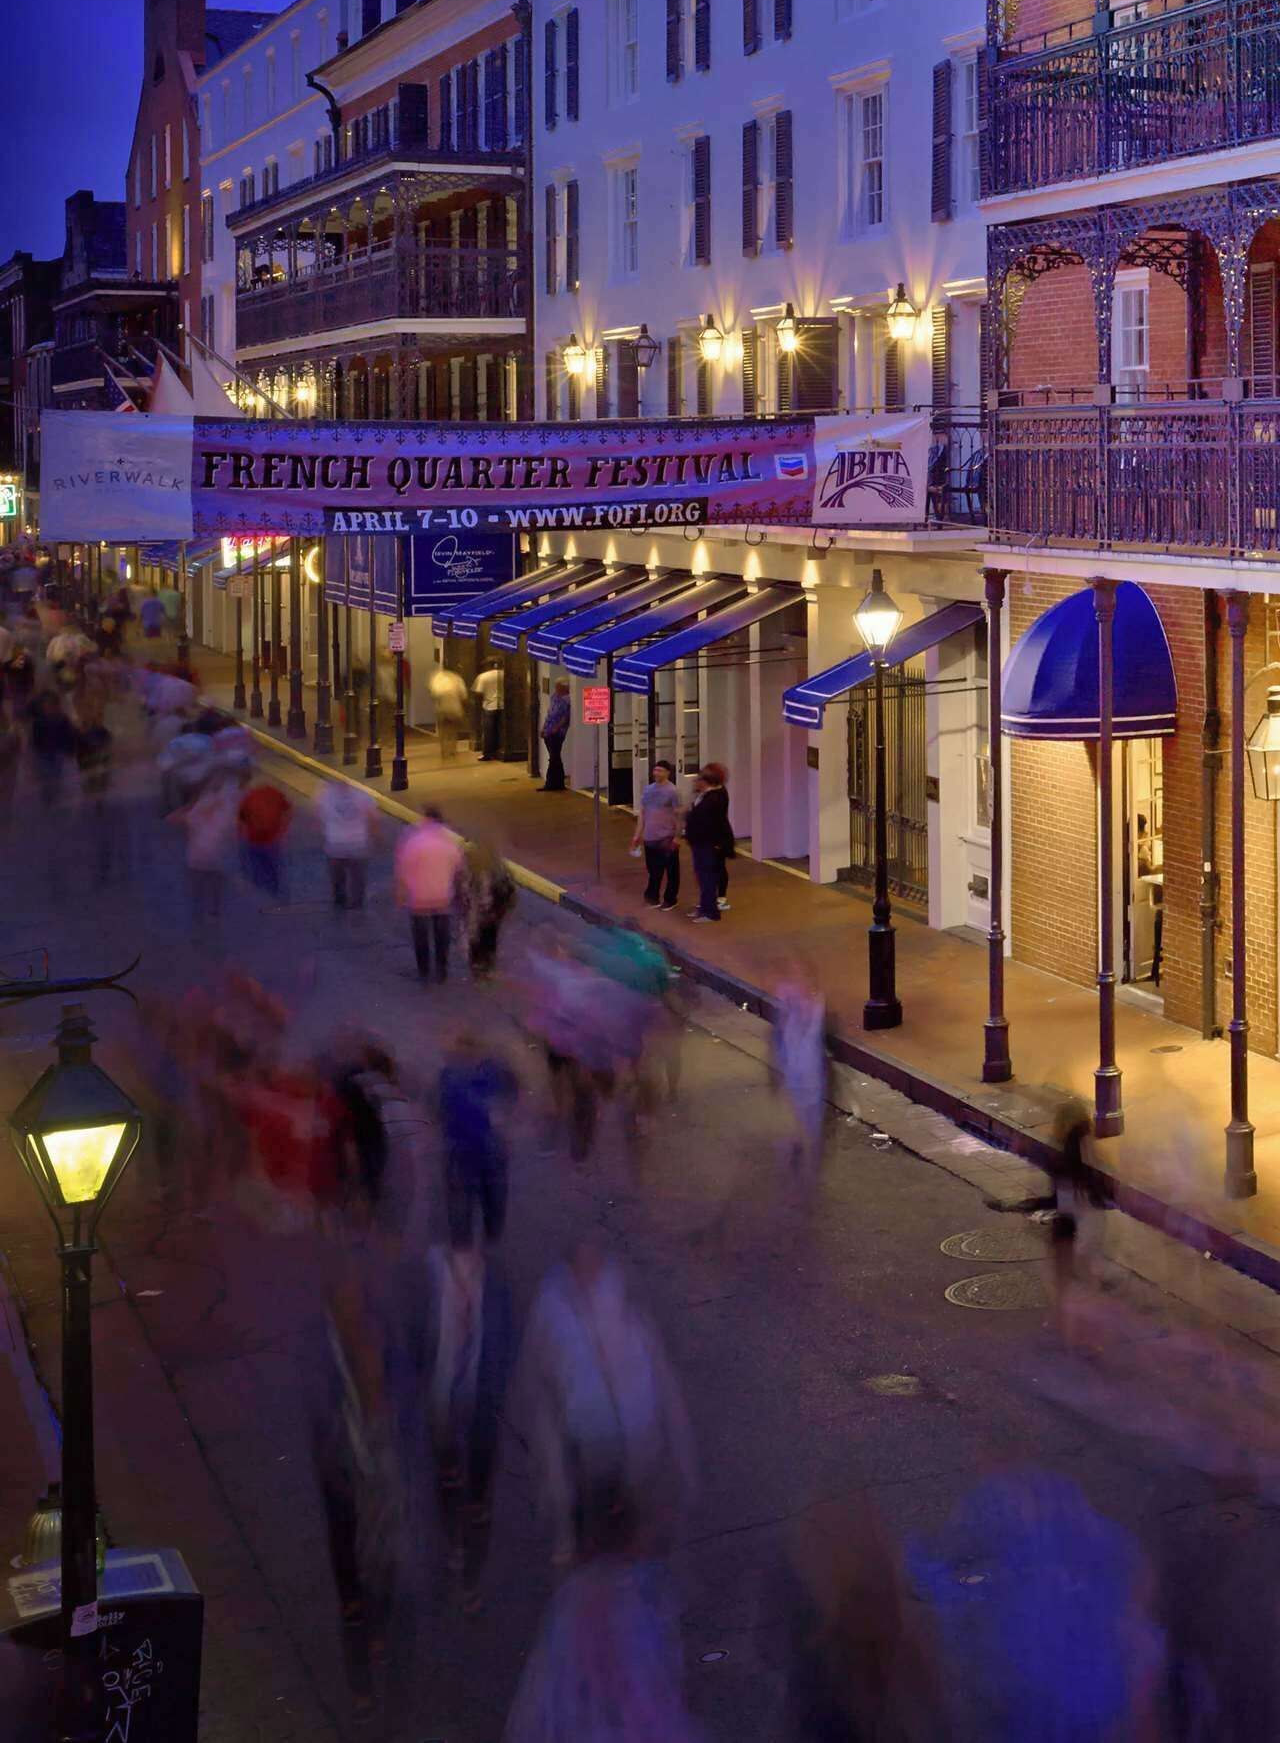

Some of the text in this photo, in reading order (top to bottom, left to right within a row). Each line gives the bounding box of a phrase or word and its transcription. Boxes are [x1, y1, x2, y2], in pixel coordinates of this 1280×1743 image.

[53, 470, 185, 491] RIVERWALK
[201, 451, 763, 496] FRENCH QUARTER FESTIVAL
[820, 451, 911, 501] ABITA
[332, 511, 410, 532] APRIL
[505, 502, 701, 528] WWW.FQFI.ORG
